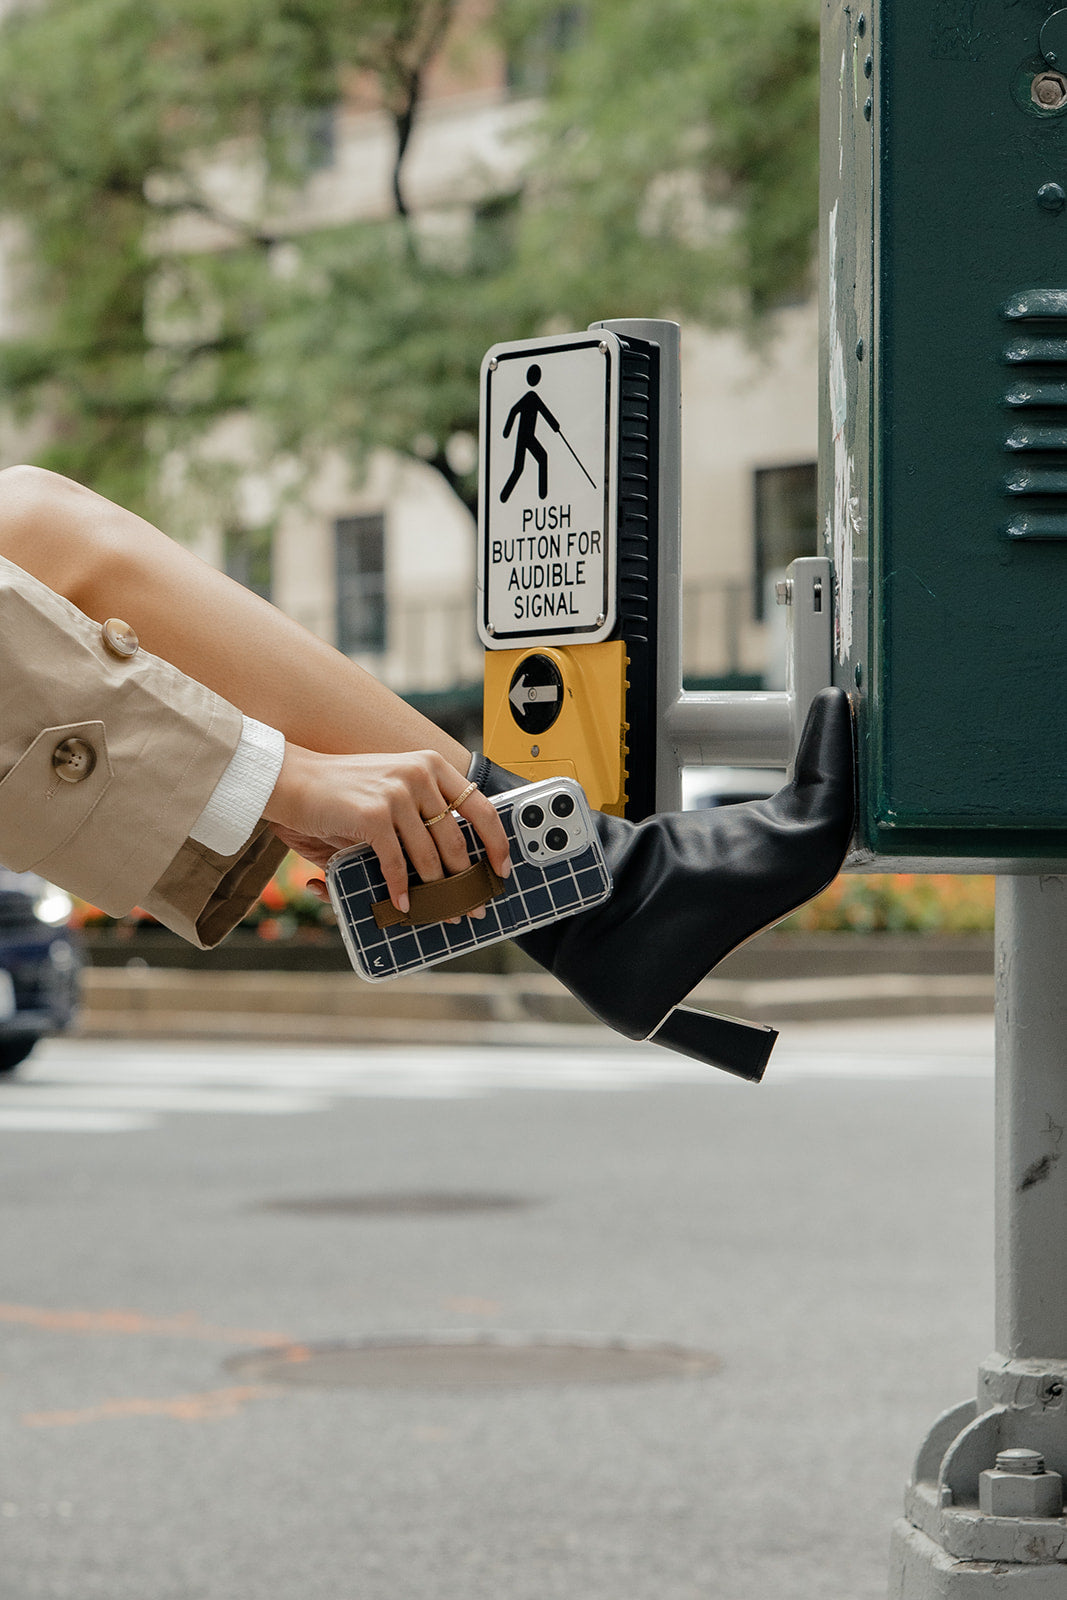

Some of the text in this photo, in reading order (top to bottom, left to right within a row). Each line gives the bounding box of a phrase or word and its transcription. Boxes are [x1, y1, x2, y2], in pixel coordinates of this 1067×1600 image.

[523, 504, 571, 532] PUSH
[492, 530, 601, 564] BUTTON FOR
[508, 560, 586, 591] AUDIBLE
[514, 591, 579, 619] SIGNAL
